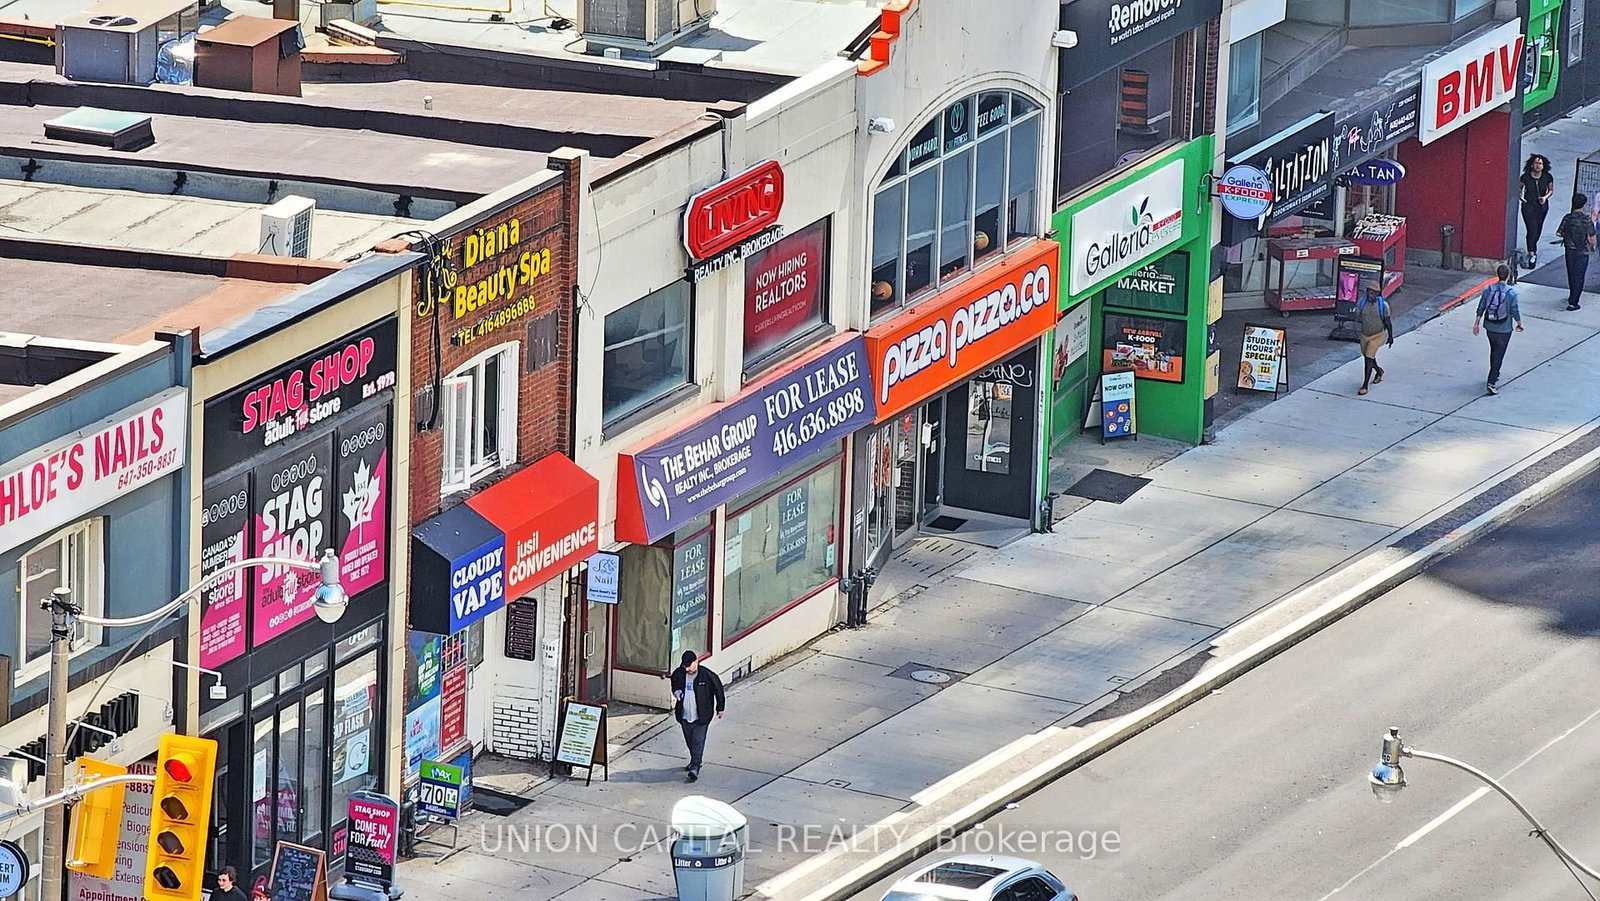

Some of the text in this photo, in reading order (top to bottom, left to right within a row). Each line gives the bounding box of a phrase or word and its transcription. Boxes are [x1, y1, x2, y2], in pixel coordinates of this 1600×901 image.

[1109, 0, 1181, 33] Remov
[1436, 36, 1525, 130] BMV
[1227, 176, 1263, 189] Galleria
[1368, 166, 1396, 180] TAN
[701, 178, 775, 240] LIVING
[465, 218, 520, 268] Diana
[694, 256, 723, 283] REALTY
[740, 226, 786, 259] BROKERAGE
[1086, 220, 1151, 277] Galleria
[455, 248, 551, 320] Beauty Spa
[756, 252, 807, 291] NOW HIRING
[755, 270, 807, 314] REALTORS
[1117, 278, 1175, 295] MARKET
[457, 295, 536, 347] TEL 4164896888
[881, 264, 1051, 404] pizza pizza.ca
[1127, 334, 1156, 343] K-FOOD
[1246, 336, 1281, 346] STUDENT
[1246, 343, 1274, 353] HOURS
[1245, 352, 1277, 361] SPECIAL
[243, 337, 375, 434] STAG SHOP
[764, 351, 860, 426] FOR LEASE
[1104, 384, 1118, 392] NOW
[264, 416, 295, 446] adult
[309, 396, 341, 424] store
[772, 388, 865, 457] 416.636.8898
[94, 407, 164, 481] NAILS
[660, 414, 757, 483] THE BEHAR GROUP
[117, 447, 178, 490] 647-350-8837
[675, 471, 699, 495] REALTY
[713, 445, 752, 475] BROKERAGE
[262, 476, 323, 543] STAG
[787, 488, 802, 506] FOR
[782, 502, 806, 525] LEASE
[202, 550, 228, 571] NUMBER
[203, 534, 236, 560] CANADA'S
[262, 520, 323, 585] SHOP
[508, 521, 597, 587] CONVENIENCE
[685, 544, 702, 563] FOR
[228, 530, 243, 600] 1
[452, 546, 504, 590] CLOUDY
[681, 558, 706, 581] LEASE
[209, 582, 234, 605] store
[595, 575, 613, 585] Nail
[452, 571, 504, 620] VAPE
[345, 712, 365, 735] FLASK
[431, 768, 452, 781] MAX
[354, 805, 391, 818] STAG SHOP
[425, 804, 447, 814] Million
[350, 831, 391, 849] FOR Fun!
[355, 819, 388, 836] COME IN
[115, 869, 145, 884] Extensi
[675, 858, 691, 867] Litter
[715, 857, 727, 867] Litter
